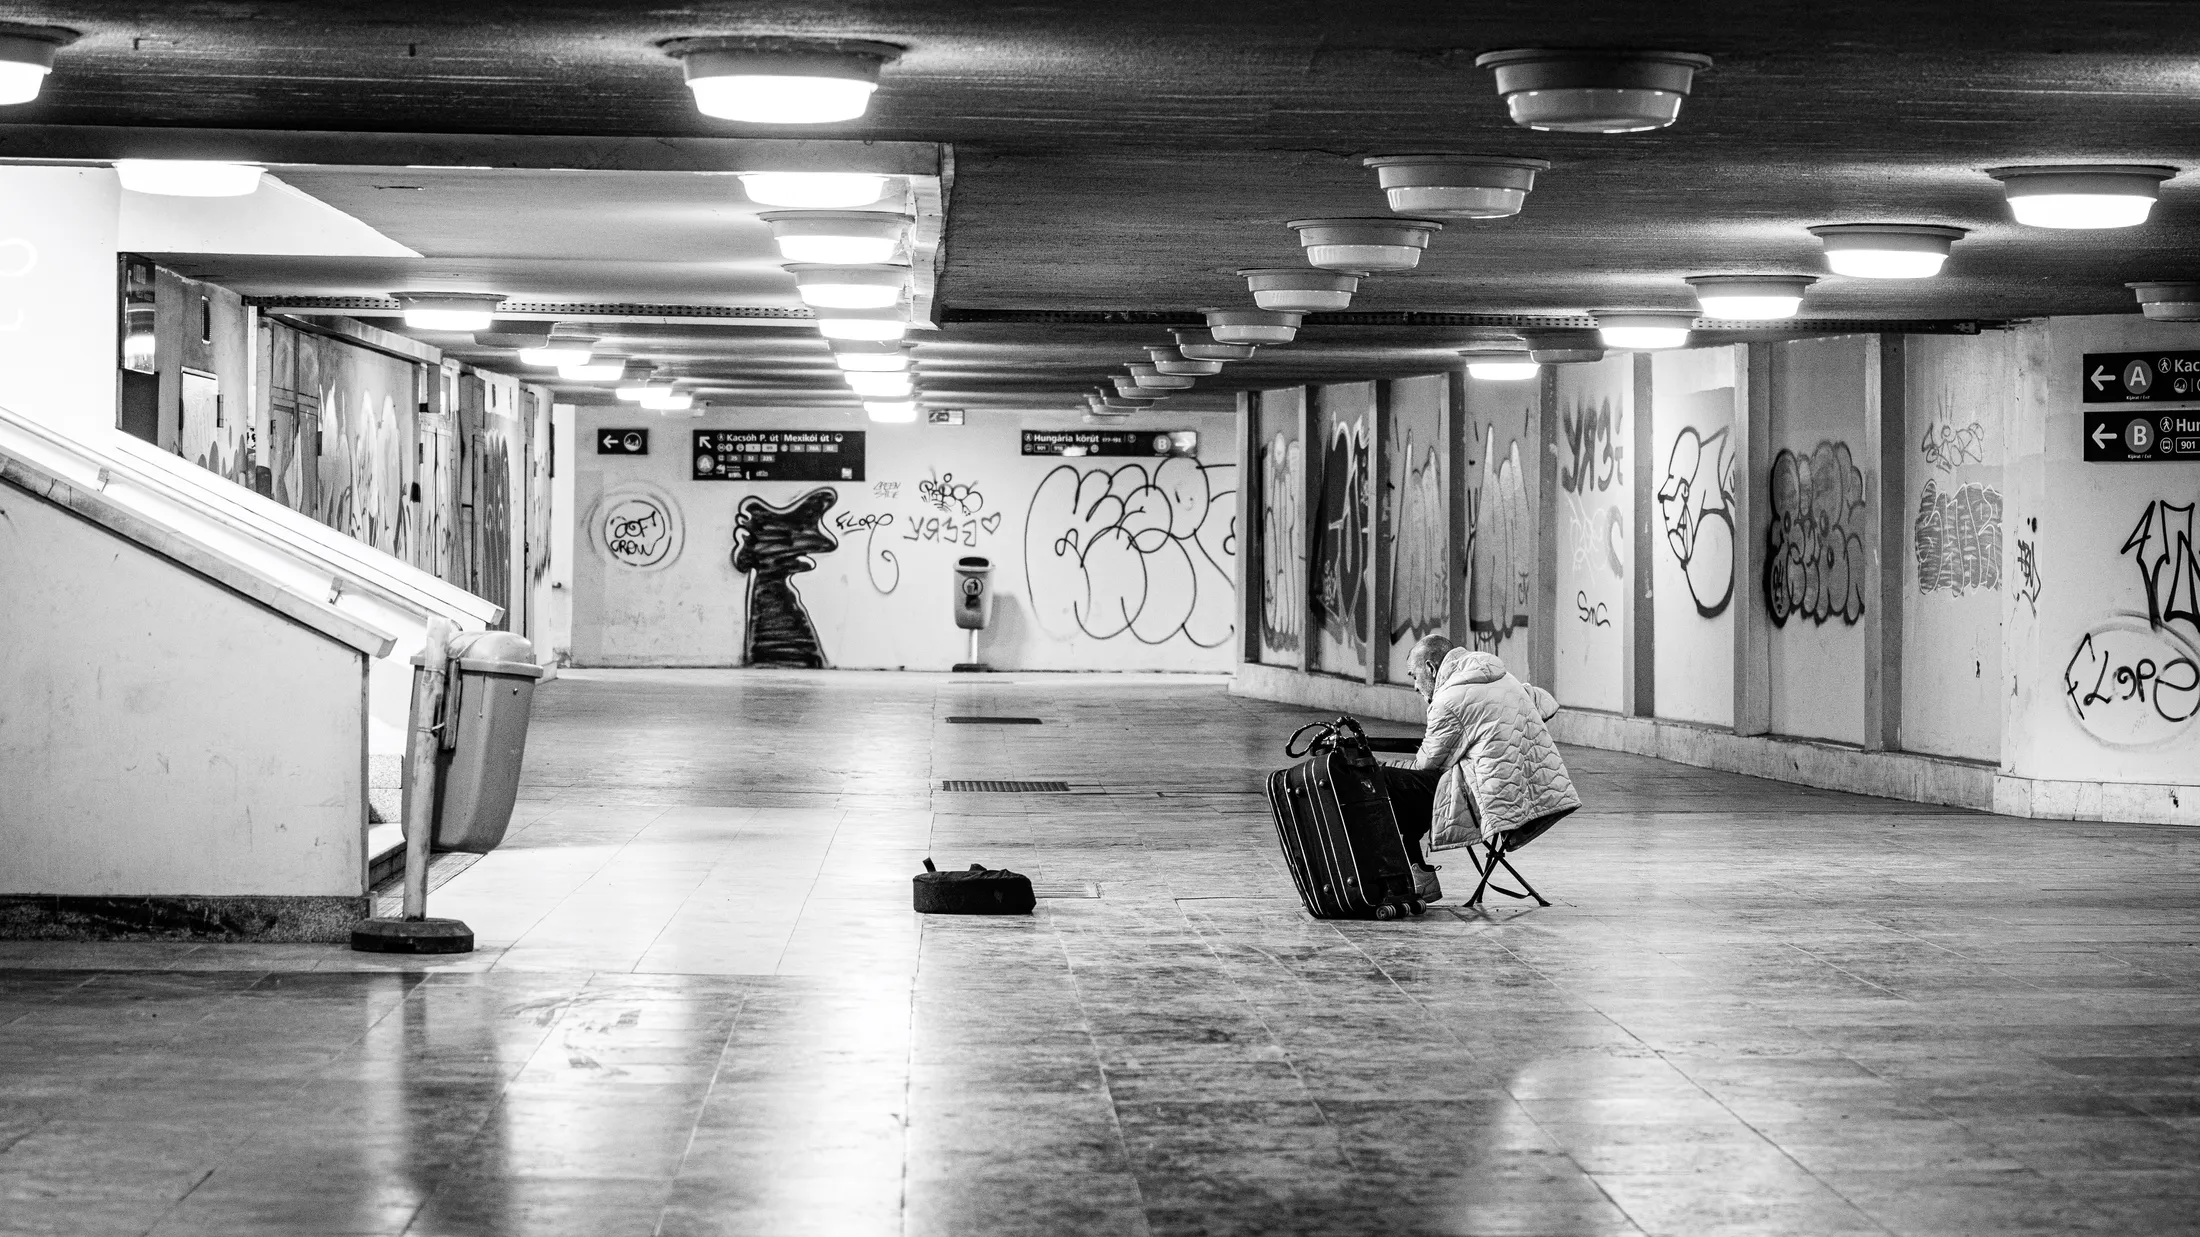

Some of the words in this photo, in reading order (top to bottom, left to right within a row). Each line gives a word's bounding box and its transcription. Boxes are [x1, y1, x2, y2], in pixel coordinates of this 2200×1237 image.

[2129, 366, 2147, 386] A
[726, 433, 757, 442] Kacsóh
[759, 433, 767, 442] P.
[769, 433, 779, 442] út
[783, 433, 818, 442] Mexikói
[820, 433, 830, 442] út
[1033, 434, 1074, 444] Hungária
[1075, 434, 1100, 442] körút
[2133, 425, 2147, 446] B
[1157, 438, 1168, 450] B
[2181, 441, 2196, 449] 901
[700, 457, 710, 469] A
